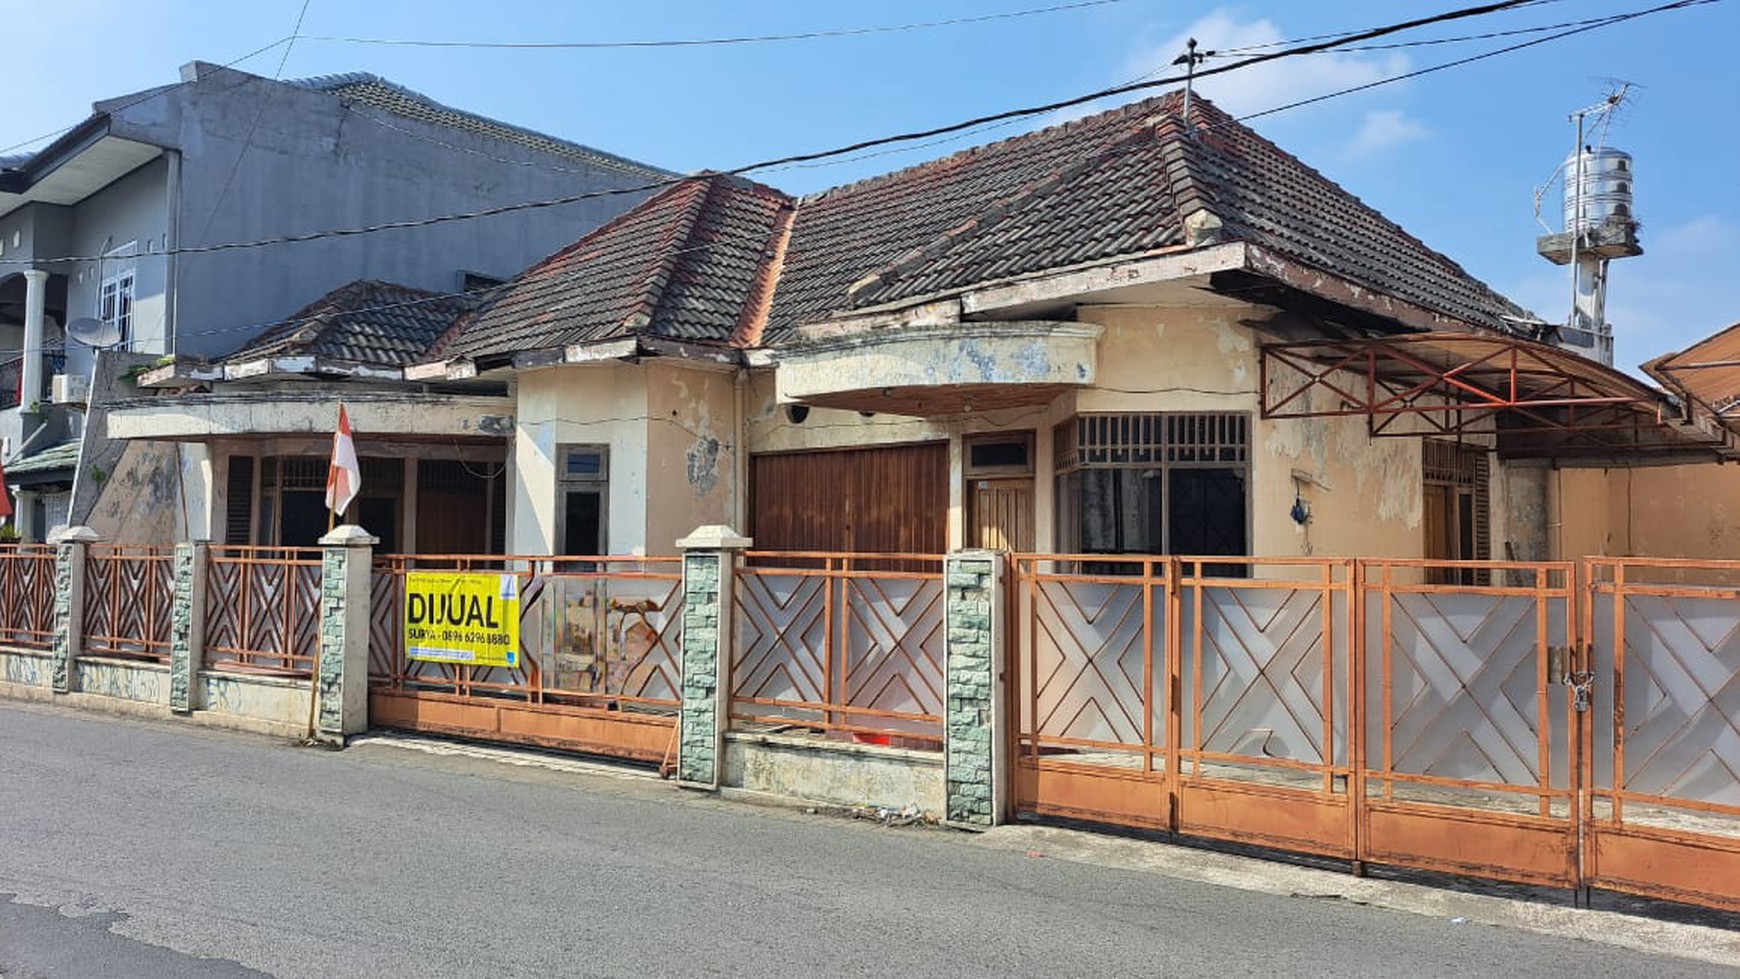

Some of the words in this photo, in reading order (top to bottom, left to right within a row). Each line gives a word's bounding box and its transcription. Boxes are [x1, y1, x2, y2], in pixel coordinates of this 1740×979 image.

[408, 593, 498, 628] DIJUAL
[408, 628, 436, 640] SURYA
[465, 631, 486, 643] 6296
